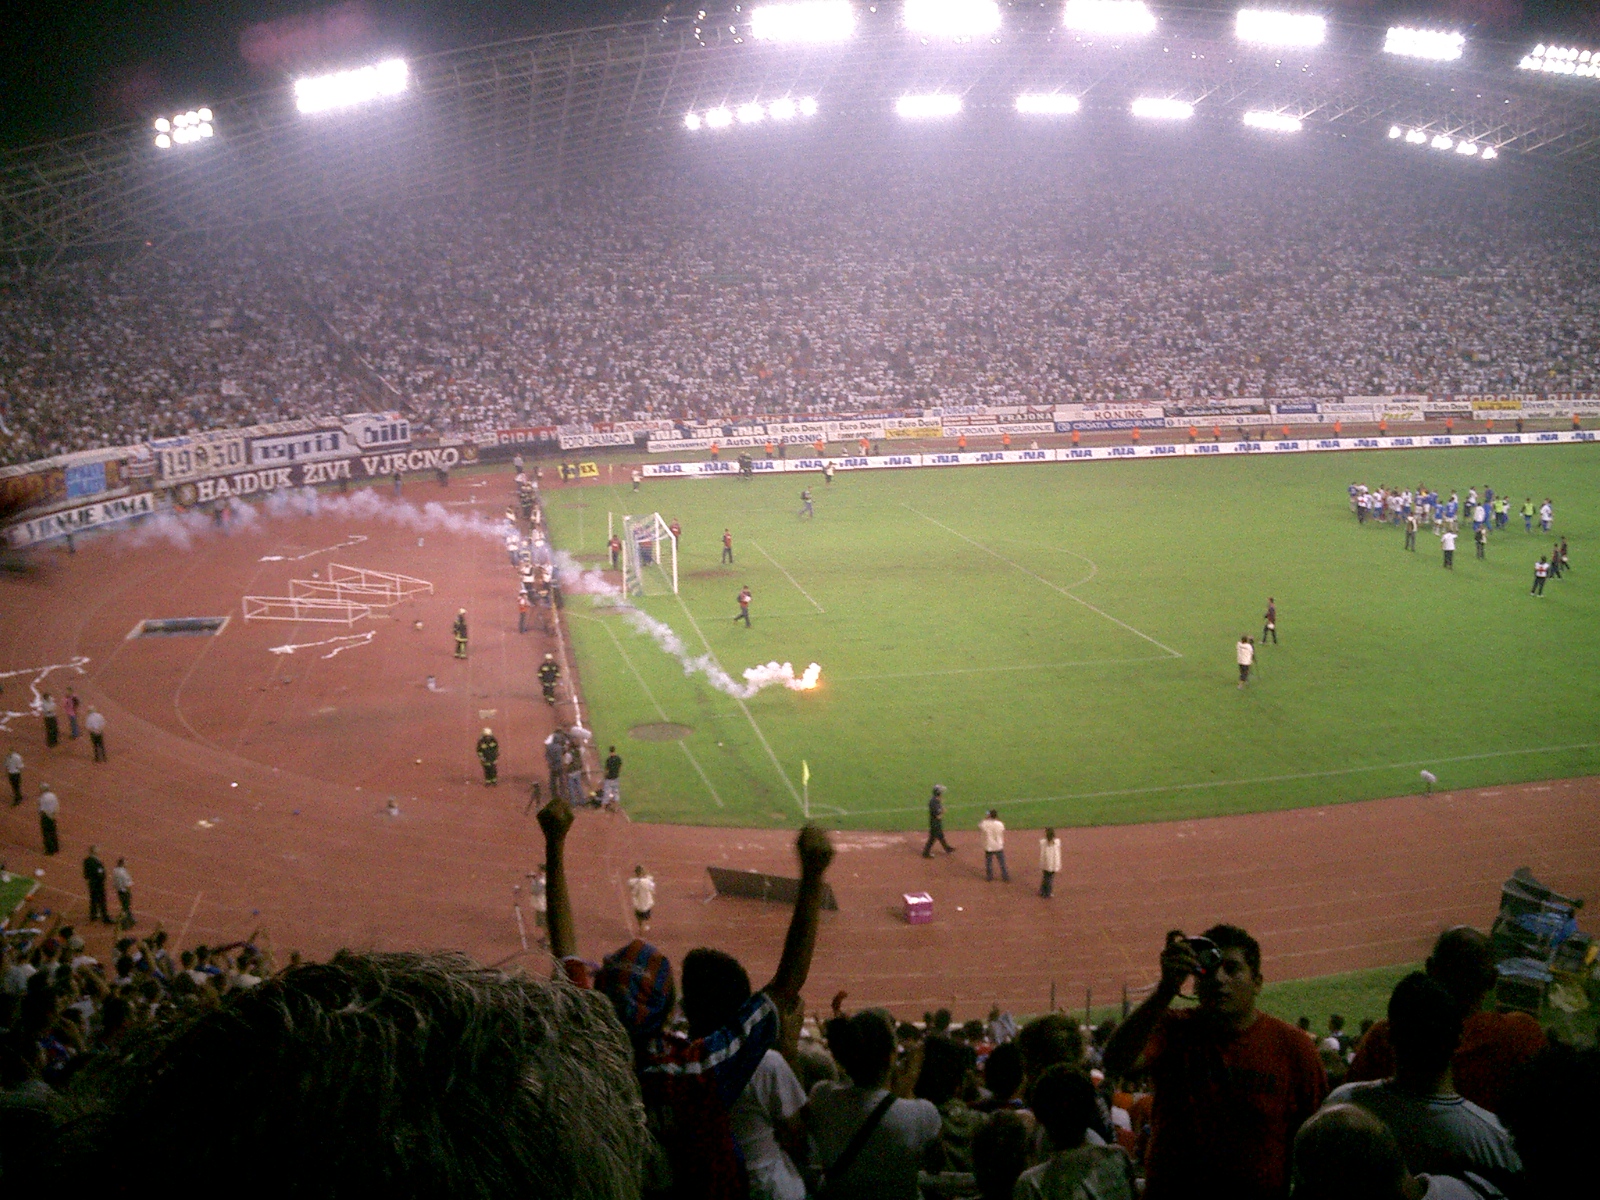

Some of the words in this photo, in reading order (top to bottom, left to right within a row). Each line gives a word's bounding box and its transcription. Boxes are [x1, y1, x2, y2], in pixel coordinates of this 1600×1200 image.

[726, 438, 750, 447] Auto
[196, 467, 293, 502] HAJDUK
[361, 447, 460, 477] VJEČNO
